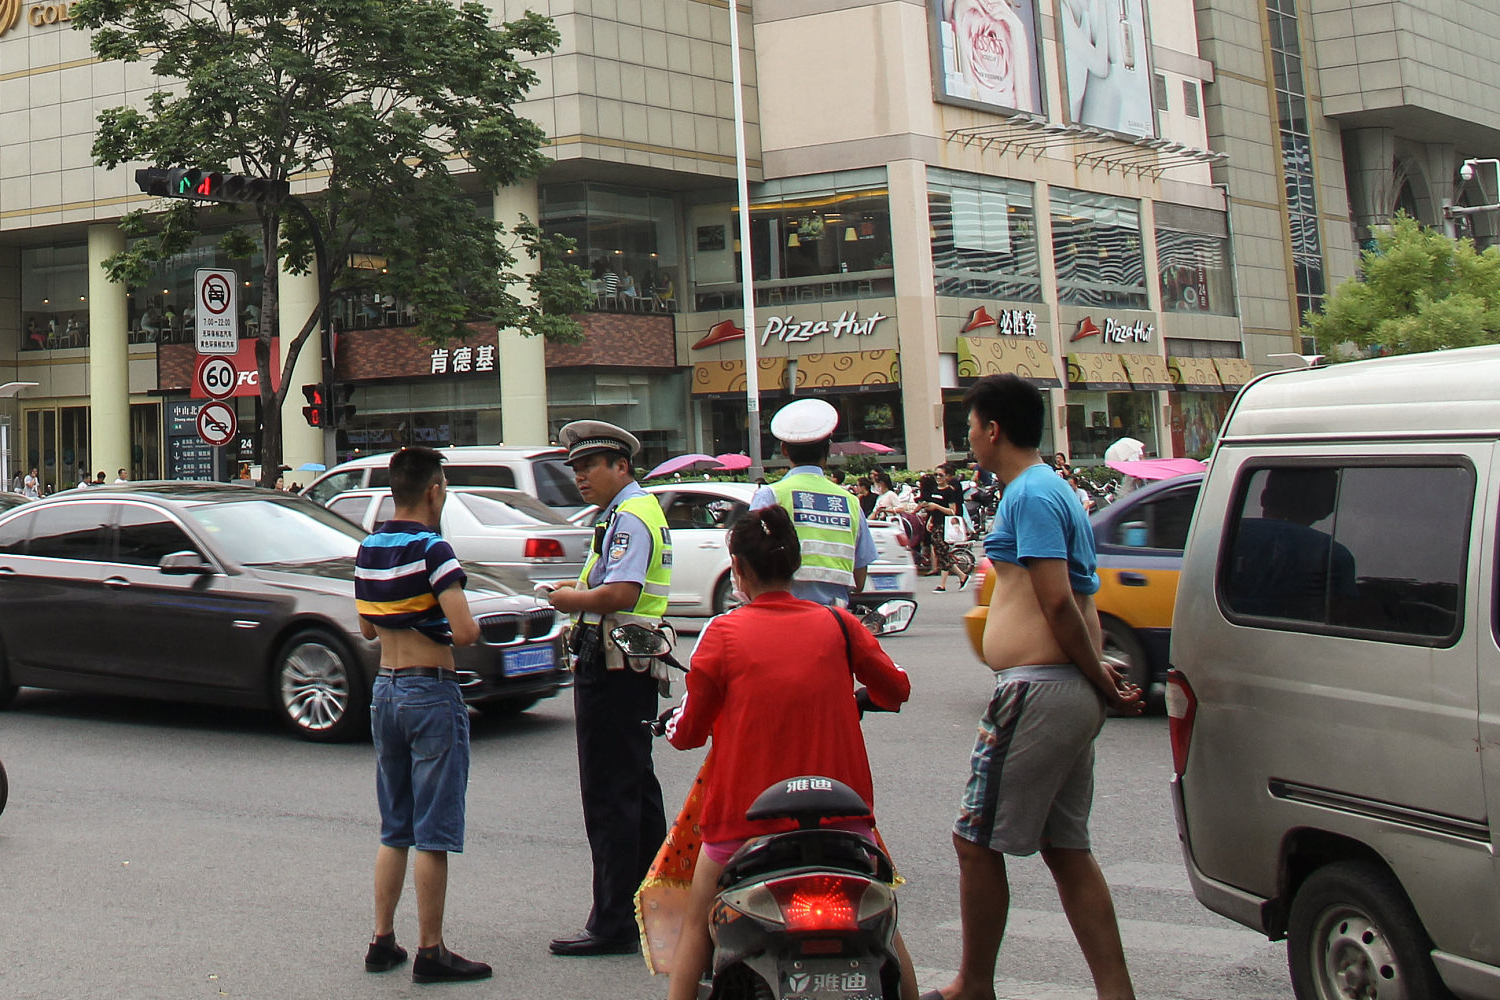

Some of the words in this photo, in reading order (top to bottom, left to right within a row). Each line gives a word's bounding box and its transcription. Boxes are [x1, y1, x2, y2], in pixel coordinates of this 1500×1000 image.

[760, 315, 830, 347] Pizza
[832, 310, 887, 339] Hut
[1000, 309, 1037, 337] 必胜客
[1104, 317, 1133, 344] Pizza
[1133, 318, 1155, 343] Hut
[431, 344, 496, 375] 肯德基
[206, 365, 231, 388] 60
[173, 405, 201, 417] 中山北
[240, 438, 254, 449] 24
[798, 492, 844, 512] 警察
[800, 513, 847, 526] POLICE
[786, 778, 833, 794] 雅迪
[813, 972, 868, 993] 雅迪
